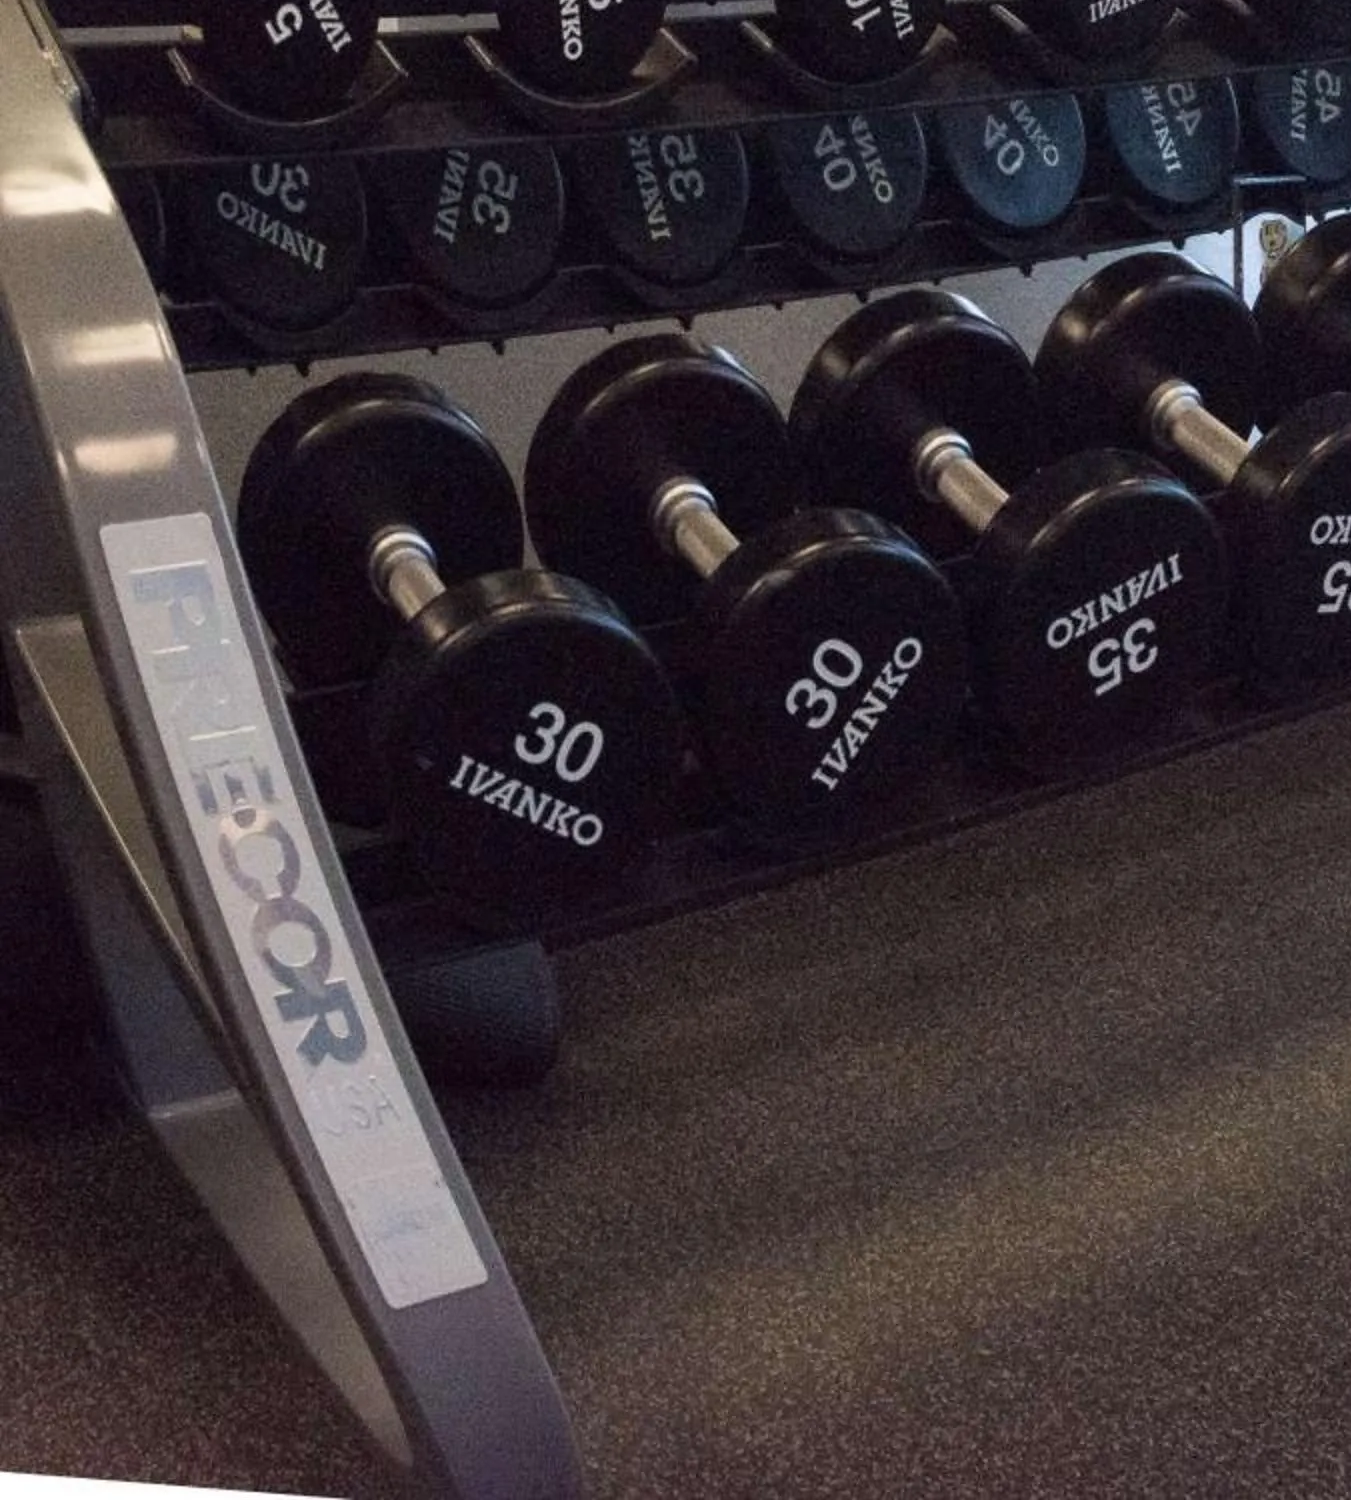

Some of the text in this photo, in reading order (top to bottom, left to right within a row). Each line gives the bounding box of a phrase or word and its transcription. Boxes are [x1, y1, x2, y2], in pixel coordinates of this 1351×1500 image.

[264, 3, 303, 44] 5
[1046, 553, 1183, 650] IVANKO
[784, 638, 862, 730] 30
[1087, 617, 1158, 696] 35
[514, 702, 604, 782] 30
[811, 637, 923, 792] IVANKO
[449, 755, 604, 847] IVANKO
